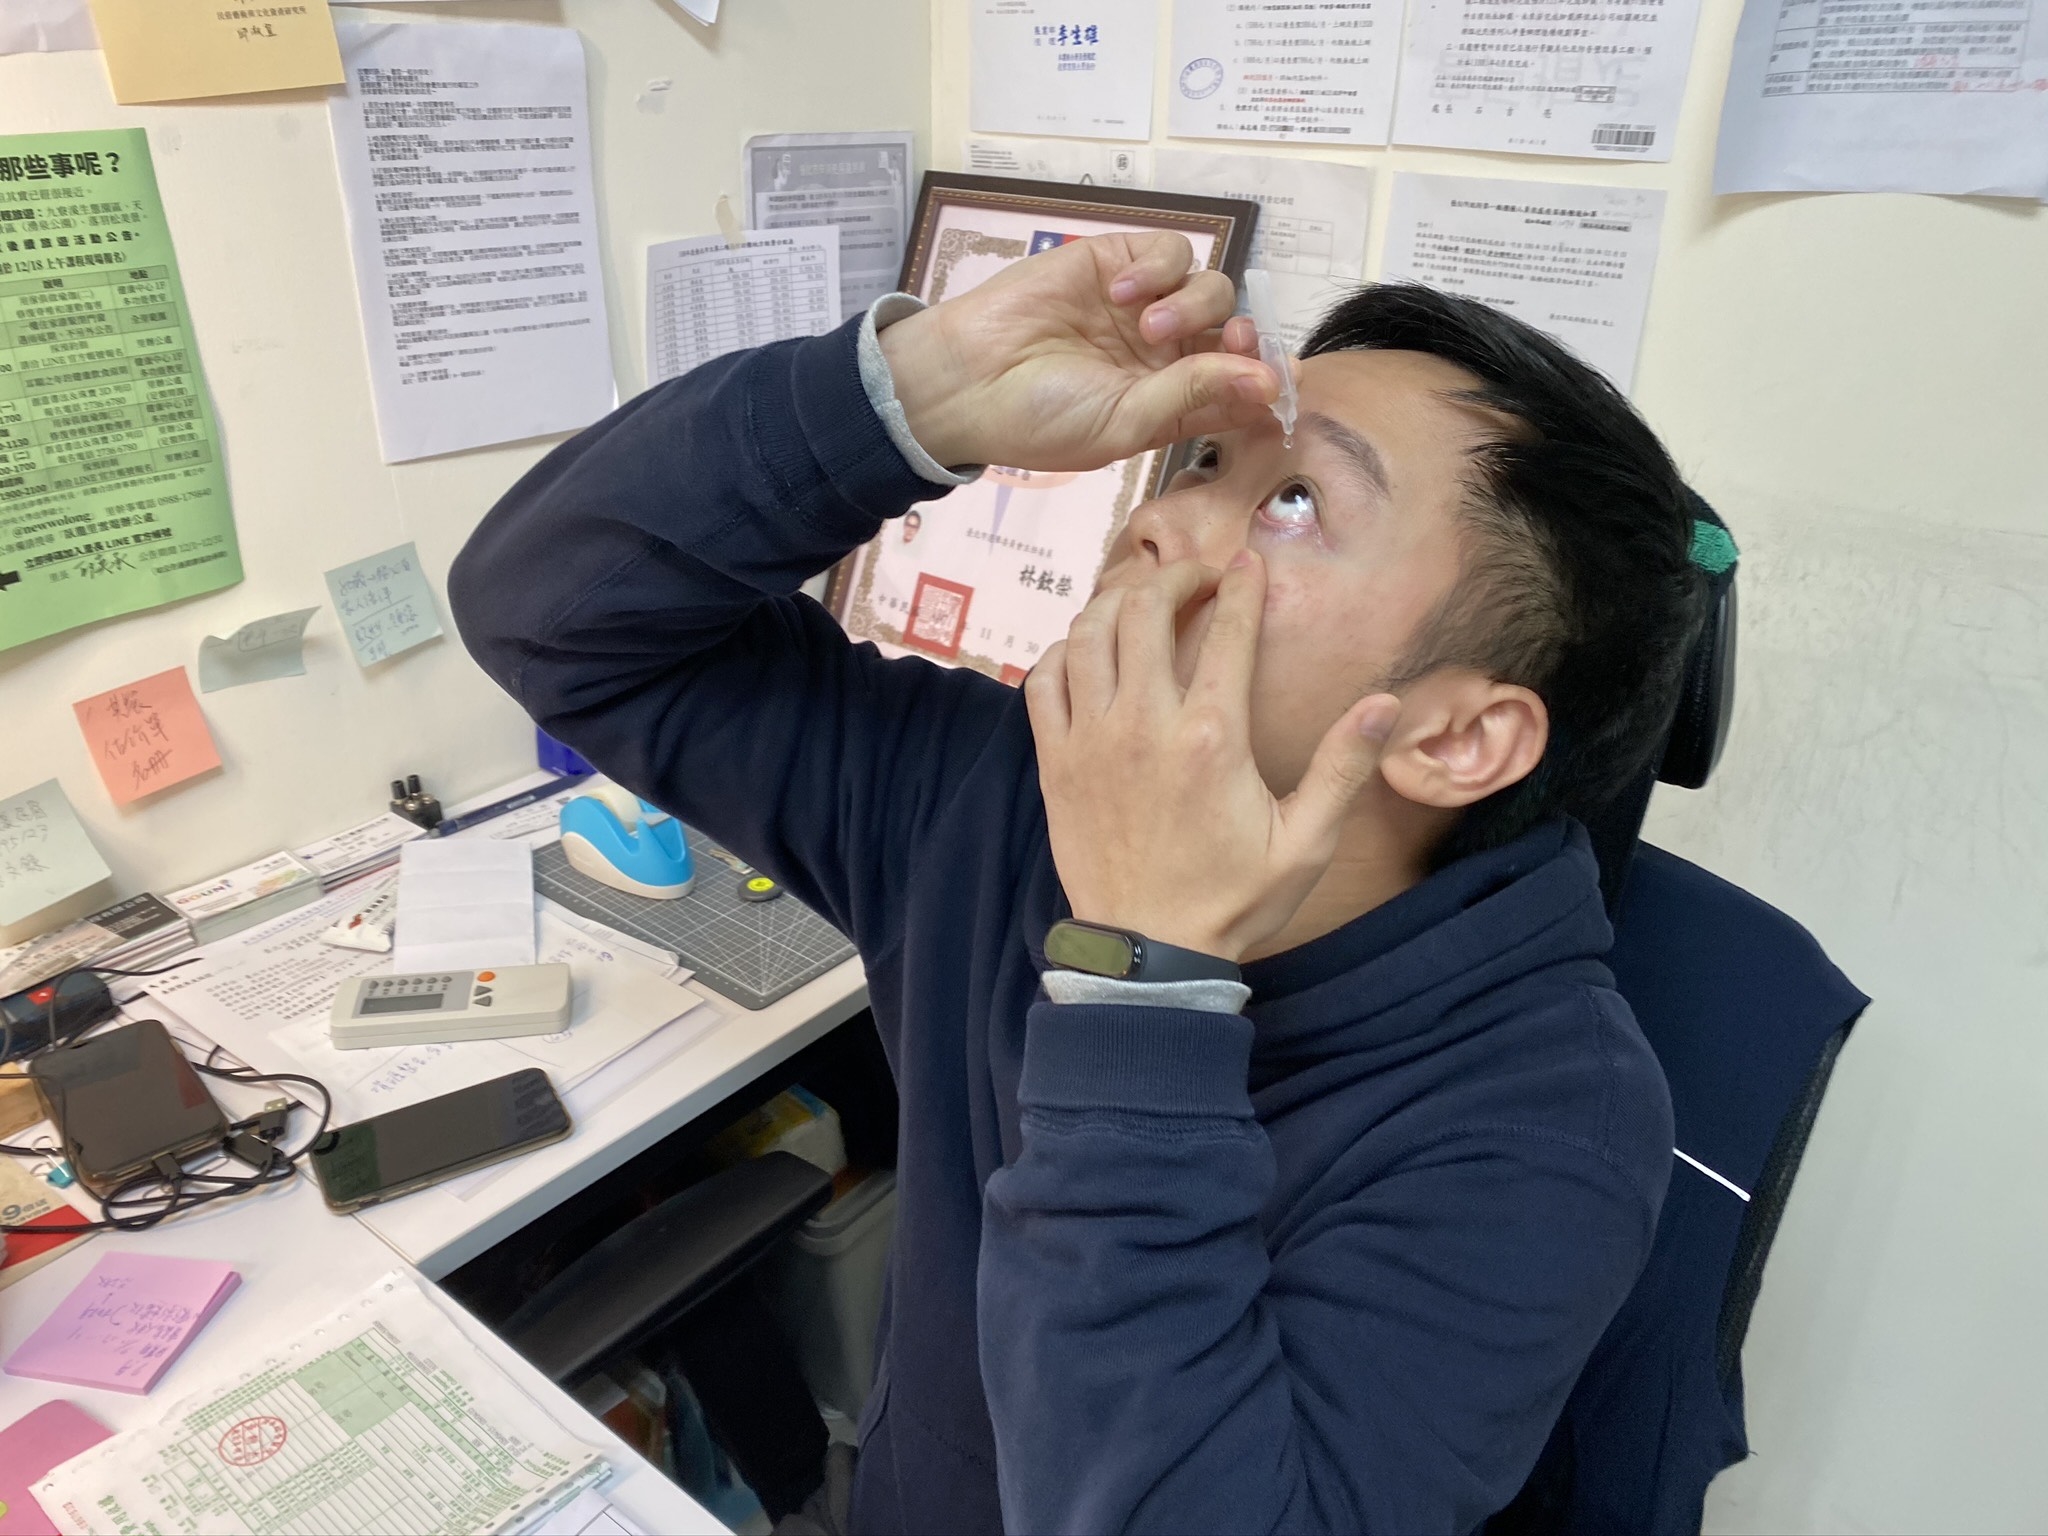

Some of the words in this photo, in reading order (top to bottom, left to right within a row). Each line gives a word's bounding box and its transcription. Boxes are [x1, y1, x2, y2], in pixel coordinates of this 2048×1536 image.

[0, 151, 121, 181] 那些事呢？
[106, 536, 129, 549] LINE
[1019, 565, 1074, 598] 林欽榮
